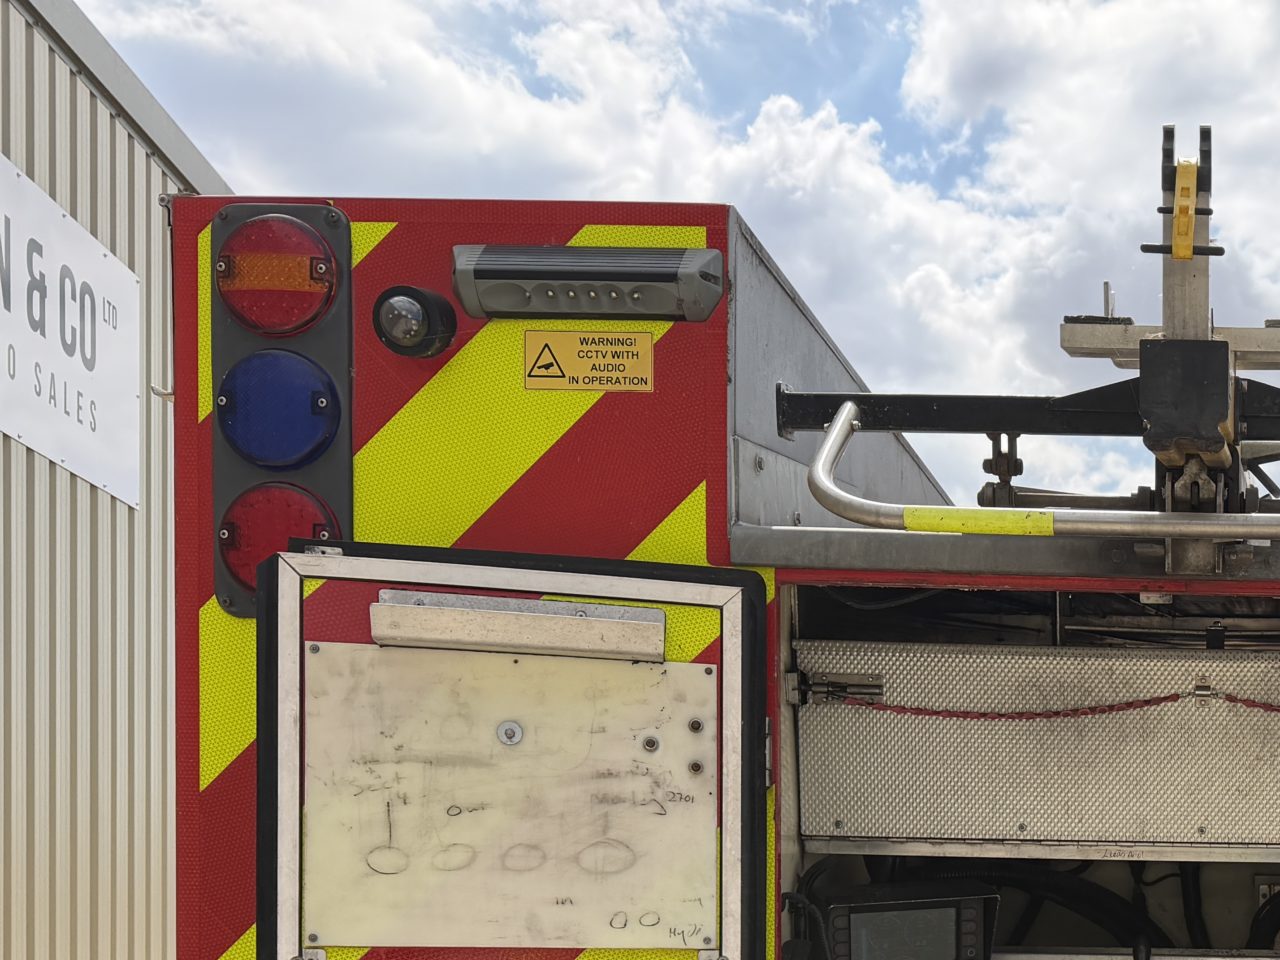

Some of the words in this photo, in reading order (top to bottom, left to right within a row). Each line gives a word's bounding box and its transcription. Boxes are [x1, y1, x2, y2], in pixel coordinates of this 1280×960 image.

[26, 237, 47, 339] &
[59, 264, 96, 372] CO
[103, 296, 117, 330] LTD
[579, 337, 637, 347] WARNING!
[577, 350, 609, 360] CCTV
[611, 351, 639, 360] WITH
[590, 363, 626, 372] AUDIO
[568, 376, 579, 385] IN
[582, 376, 648, 386] OPERATION
[34, 361, 97, 433] SALES
